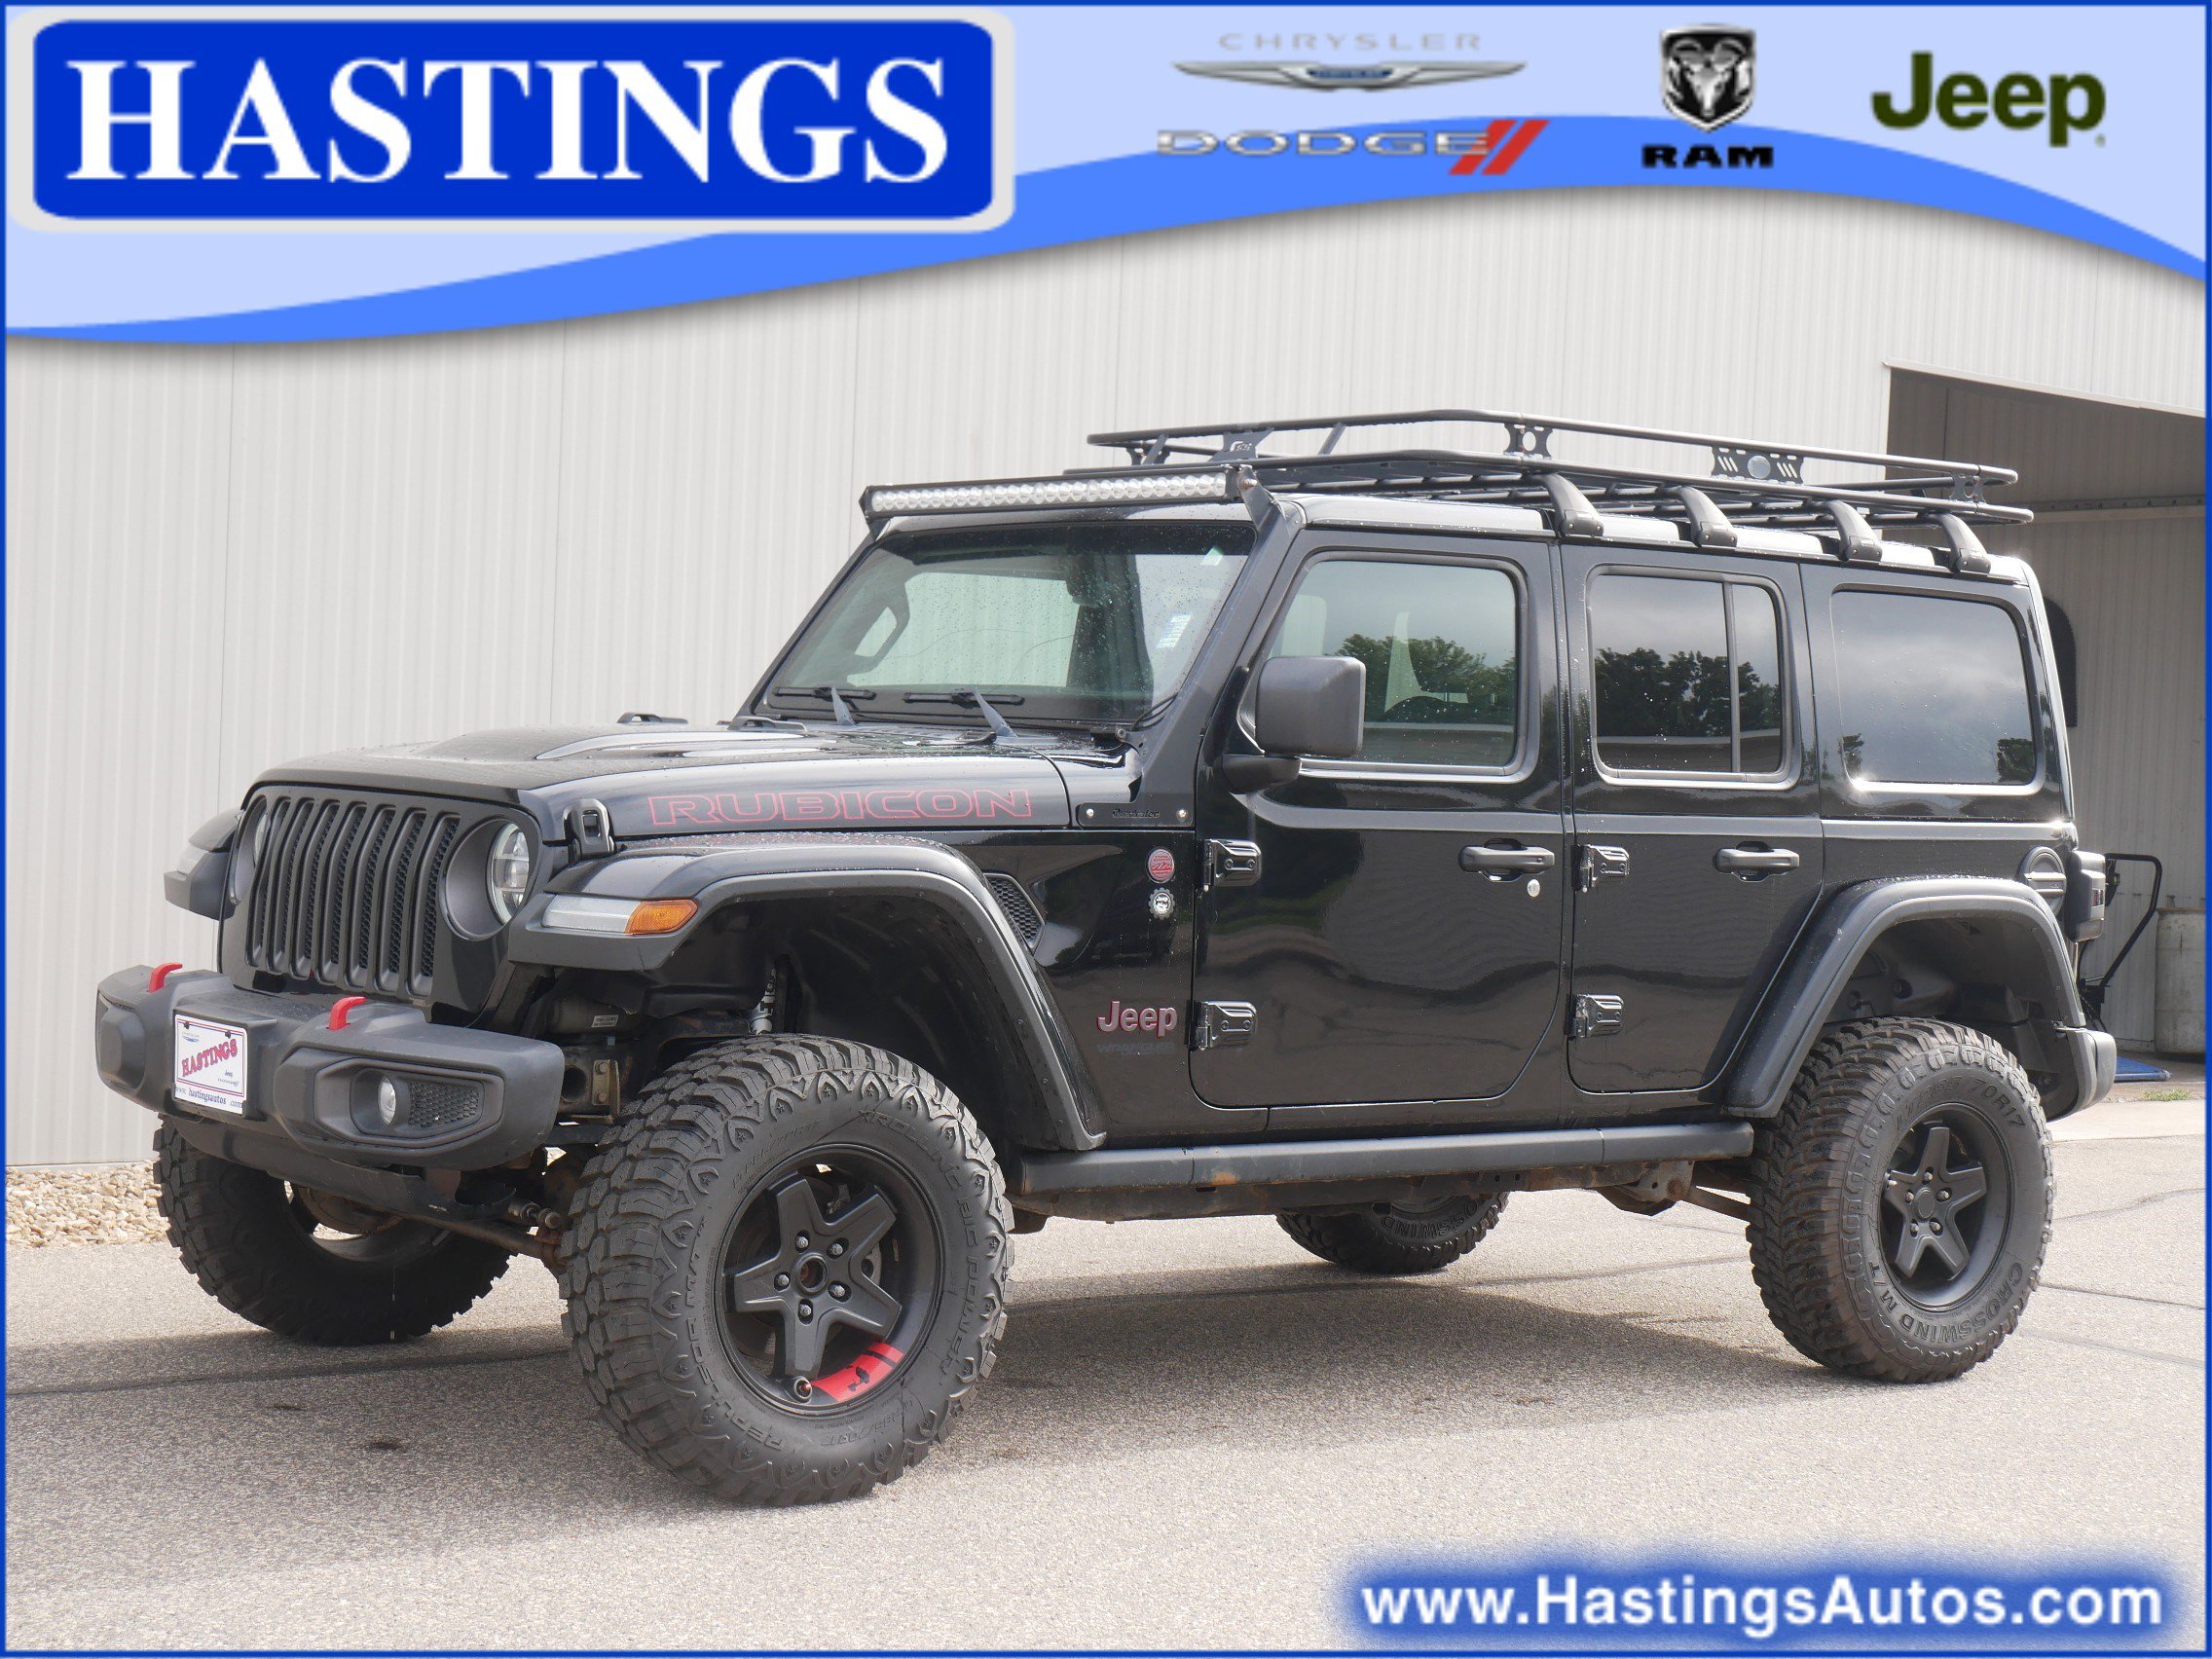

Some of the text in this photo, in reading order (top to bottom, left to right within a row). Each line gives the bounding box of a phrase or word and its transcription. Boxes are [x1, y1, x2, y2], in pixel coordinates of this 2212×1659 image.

[646, 789, 1033, 827] RUBICON
[1096, 1001, 1178, 1038] Jeep
[182, 1038, 239, 1078] HASTINGS
[1899, 1263, 2023, 1345] CROSSWIND
